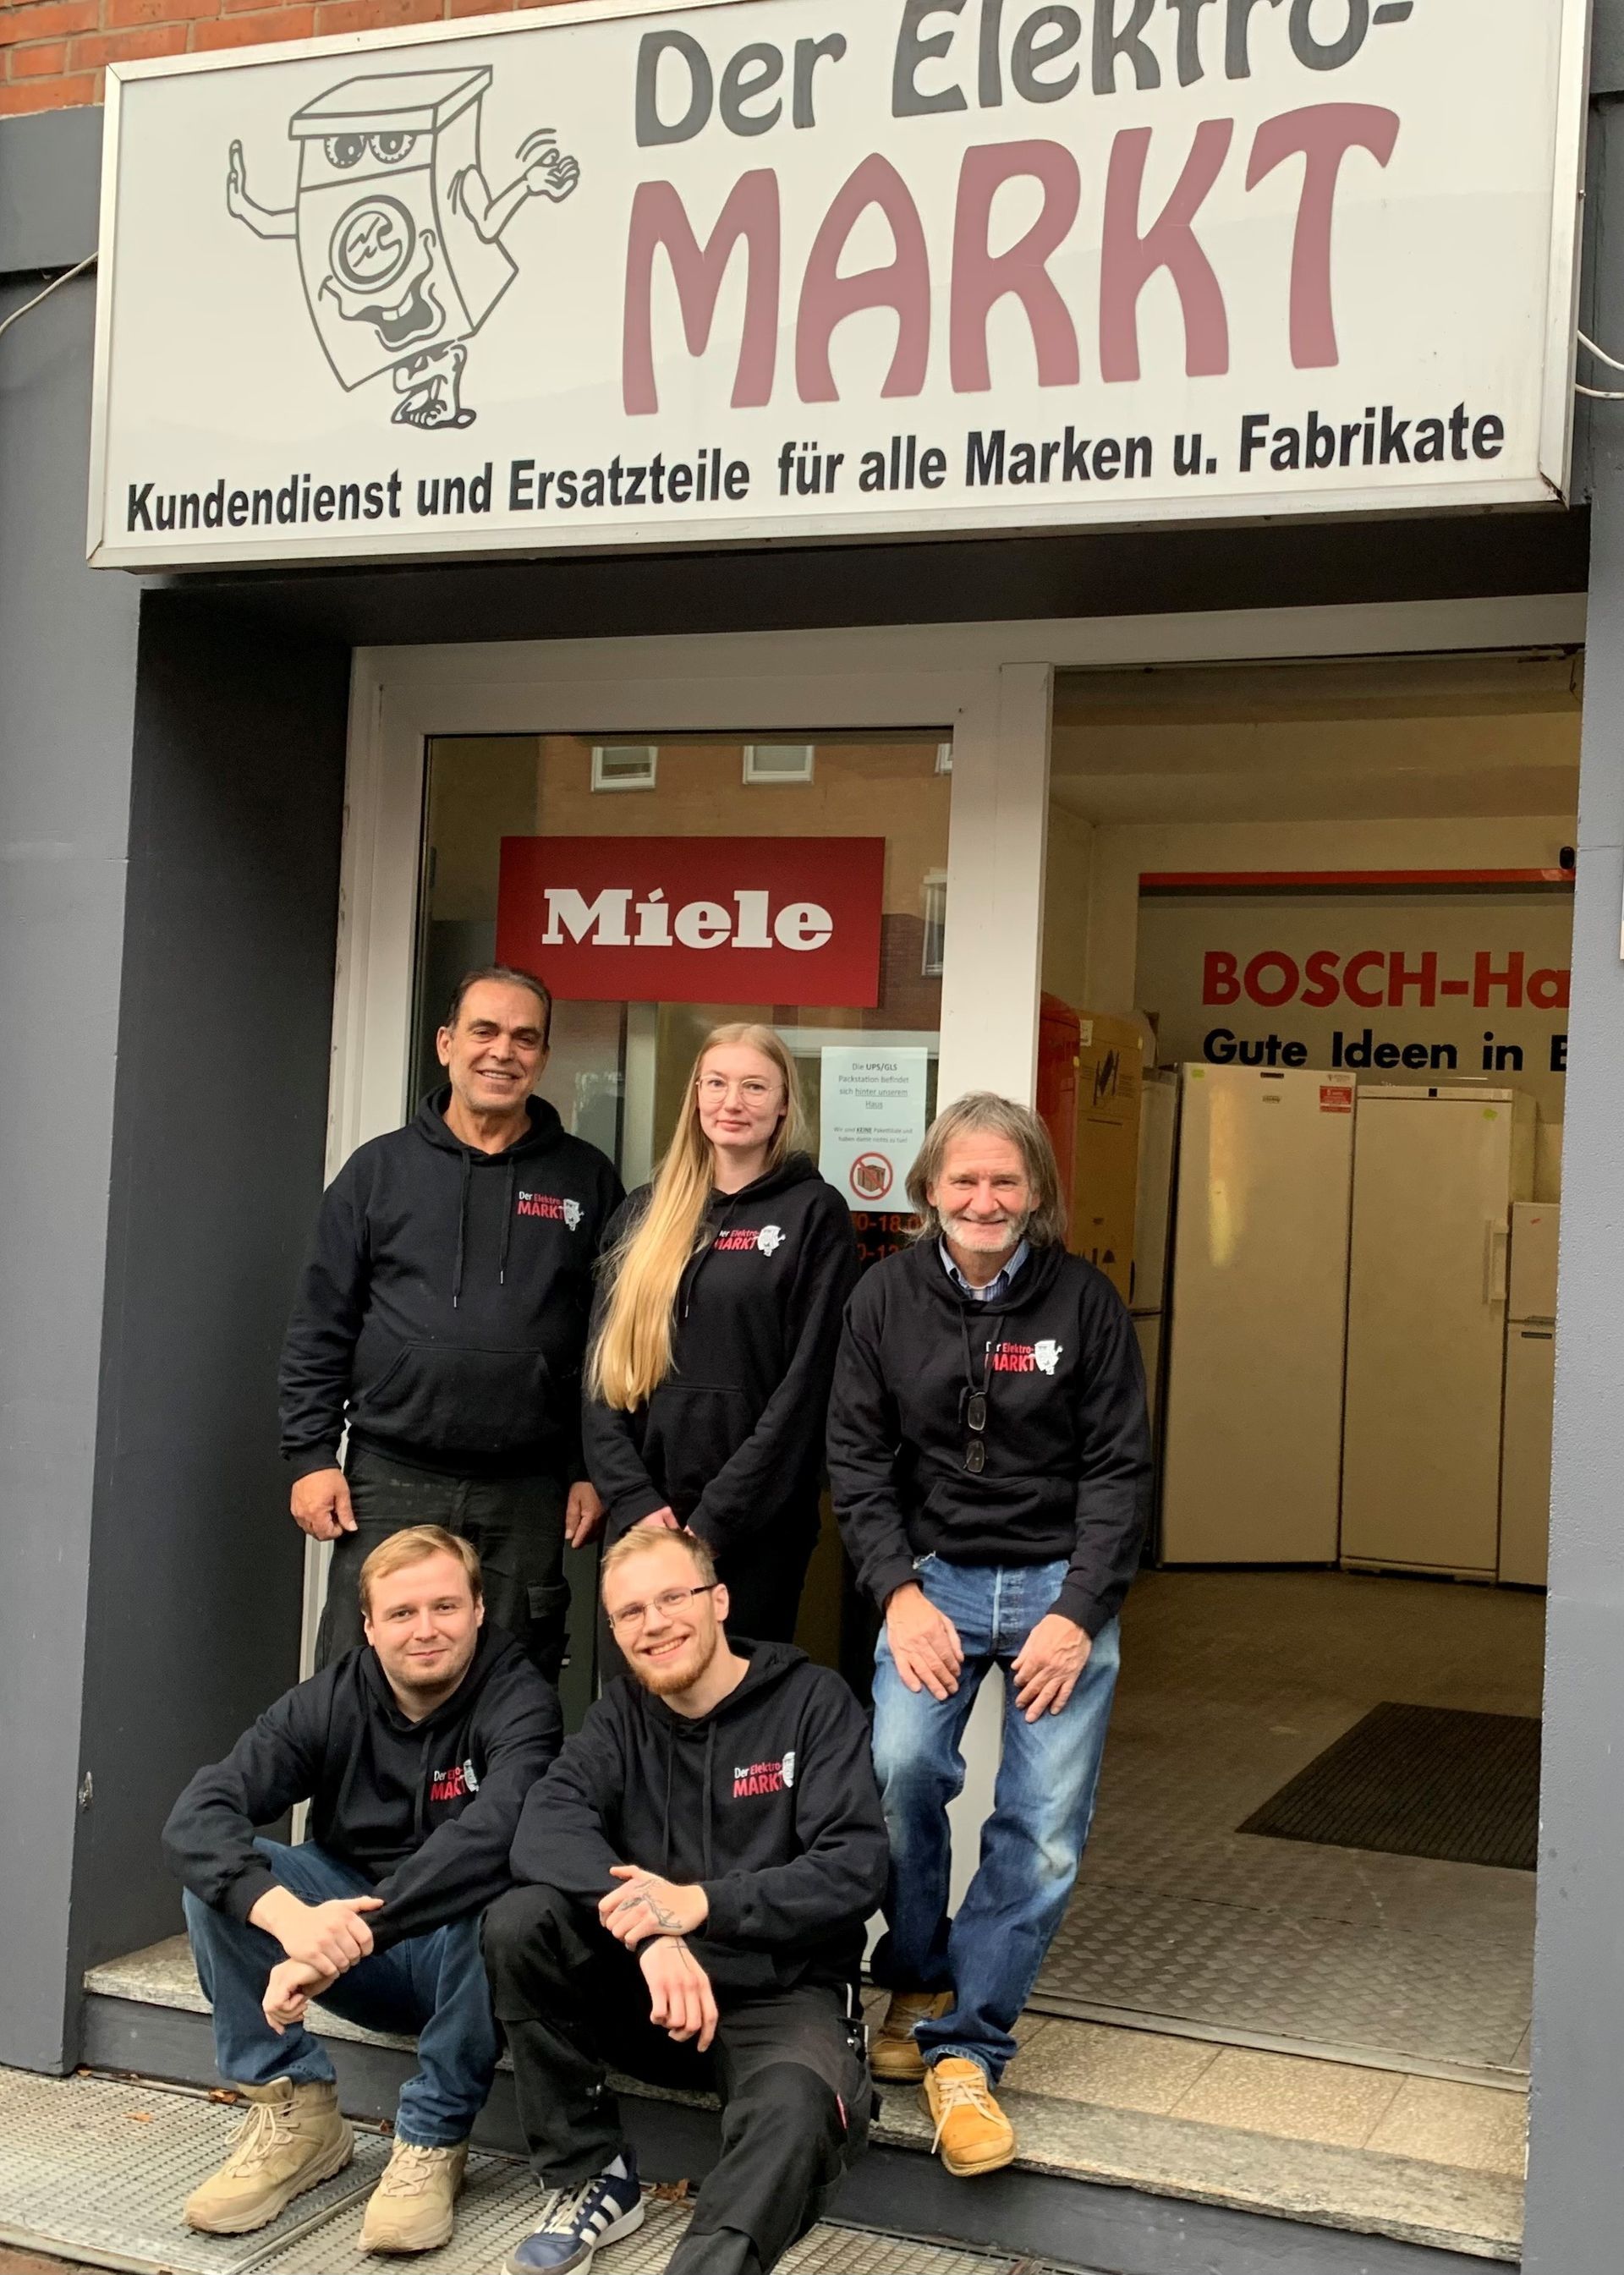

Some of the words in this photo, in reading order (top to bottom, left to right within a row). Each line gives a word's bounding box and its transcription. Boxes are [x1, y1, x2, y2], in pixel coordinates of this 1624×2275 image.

[635, 30, 848, 148] Der
[892, 0, 1414, 118] Elektro-
[622, 102, 1401, 416] MARKT
[127, 469, 403, 532] Kundendienst
[417, 462, 493, 517] und
[508, 447, 750, 512] Ersatzteile
[777, 441, 845, 496] für
[859, 435, 947, 492] alle
[965, 425, 1153, 487] Marken
[1173, 433, 1218, 477] u.
[1239, 401, 1506, 473] Fabrikate
[541, 887, 834, 951] Miele
[1203, 1028, 1308, 1067] Gute
[1331, 1028, 1457, 1070] Ideen
[1482, 1031, 1523, 1072] in
[865, 1063, 898, 1072] UPS/GLS
[838, 1075, 880, 1083] Packstation
[854, 1088, 876, 1097] hinter
[878, 1088, 908, 1098] unserem
[865, 1100, 883, 1110] Haus
[518, 1191, 534, 1201] Der
[1001, 1342, 1034, 1354] Elektro-
[433, 1770, 447, 1782] Der
[734, 1767, 749, 1779] Der
[732, 1772, 783, 1798] MARKT
